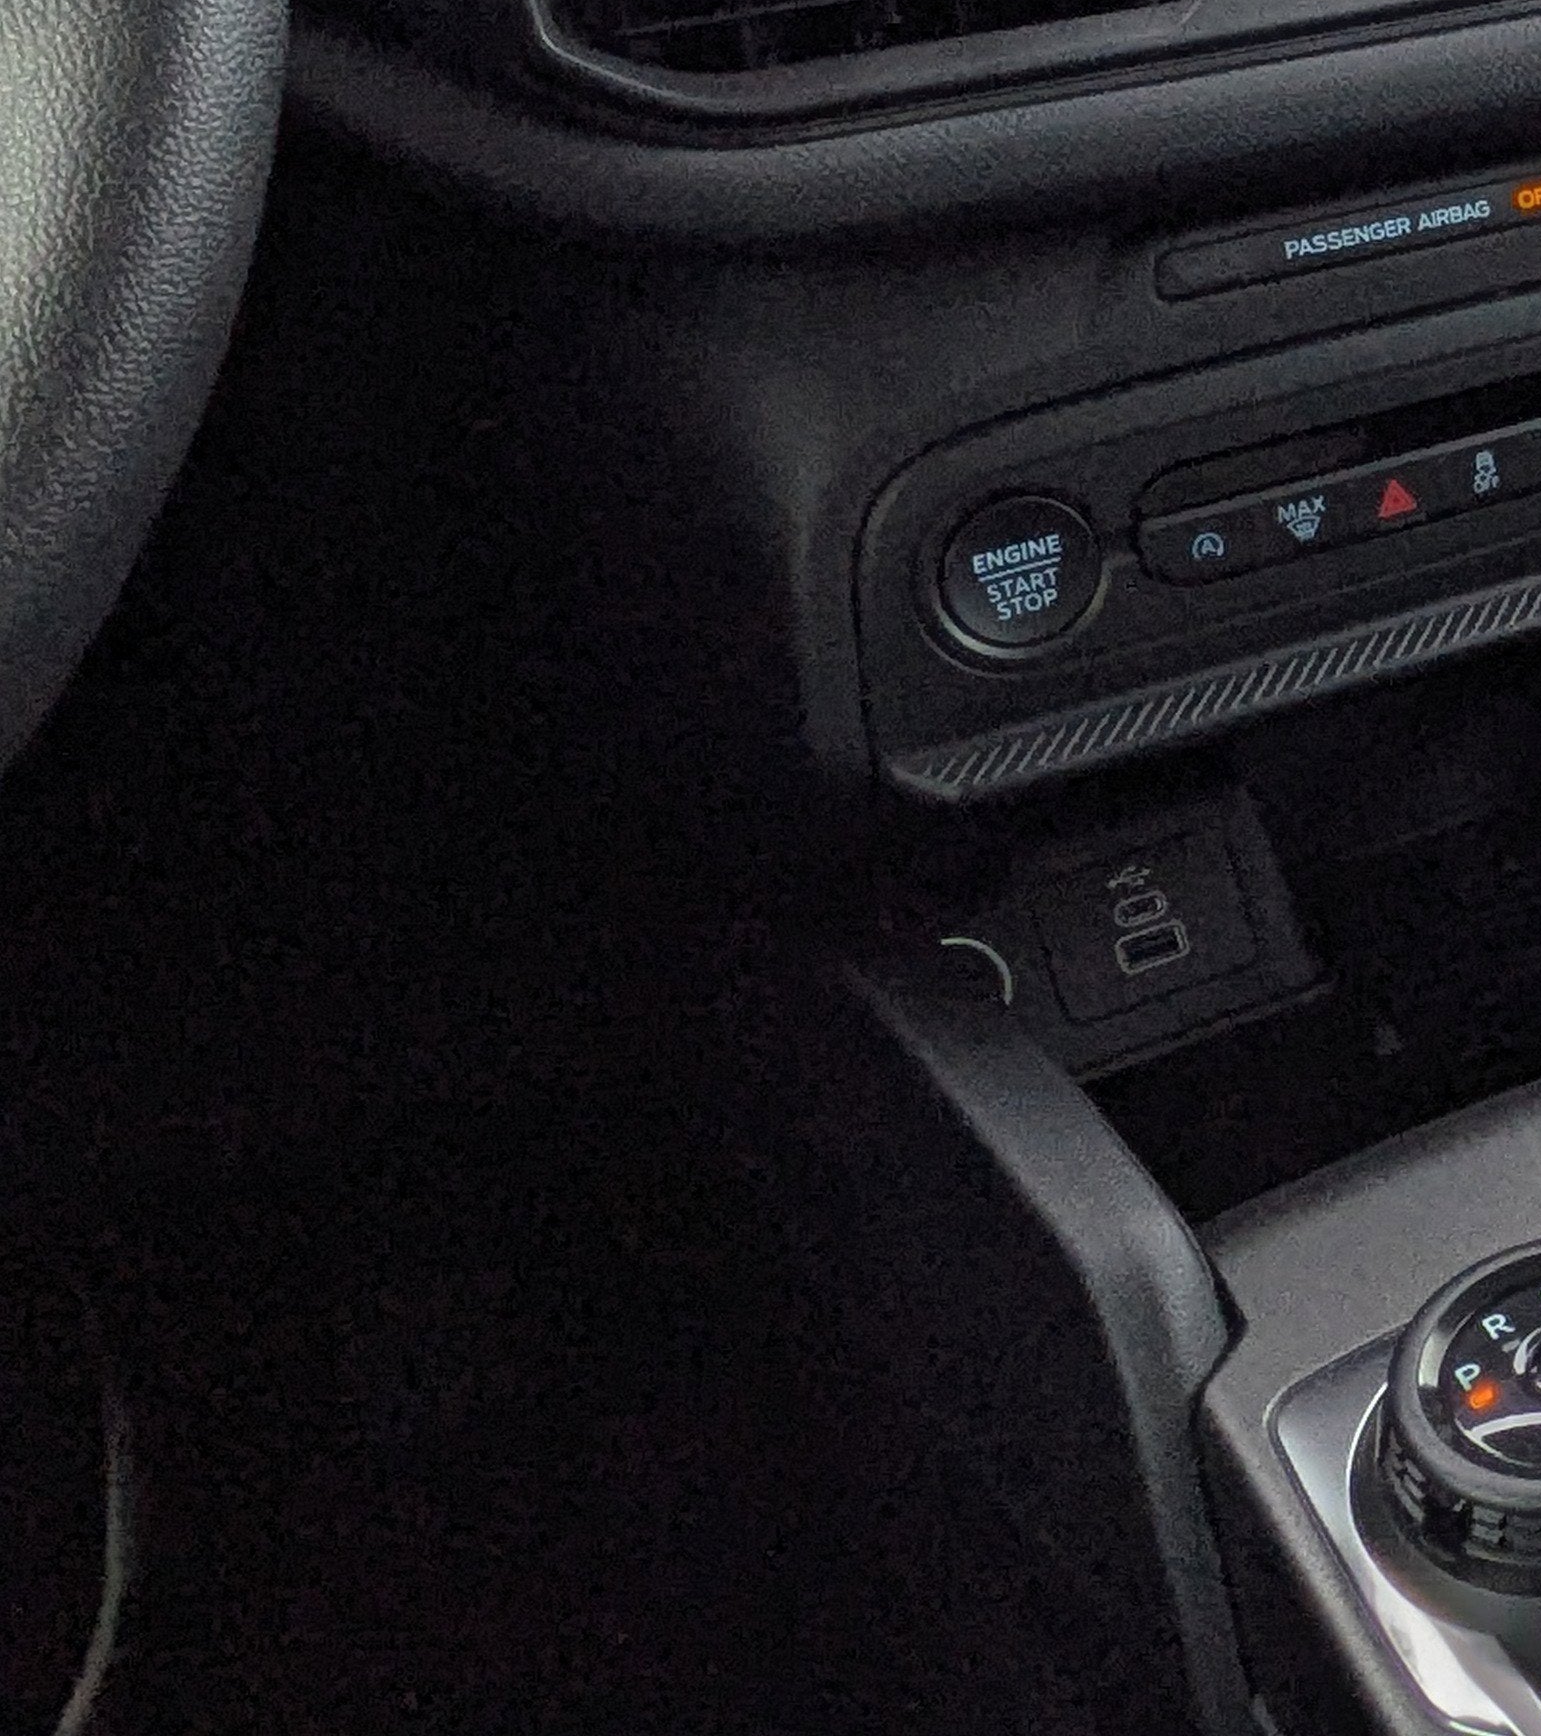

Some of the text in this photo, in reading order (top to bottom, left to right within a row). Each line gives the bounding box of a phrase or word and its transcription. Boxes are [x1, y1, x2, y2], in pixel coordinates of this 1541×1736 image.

[1284, 217, 1412, 260] PASSENGER
[1417, 200, 1491, 231] AIRBAG
[1277, 495, 1326, 523] MAX
[973, 534, 1063, 574] ENGINE
[986, 567, 1058, 604] START
[997, 588, 1059, 621] STOP
[1482, 1313, 1515, 1340] R
[1454, 1363, 1480, 1391] P
